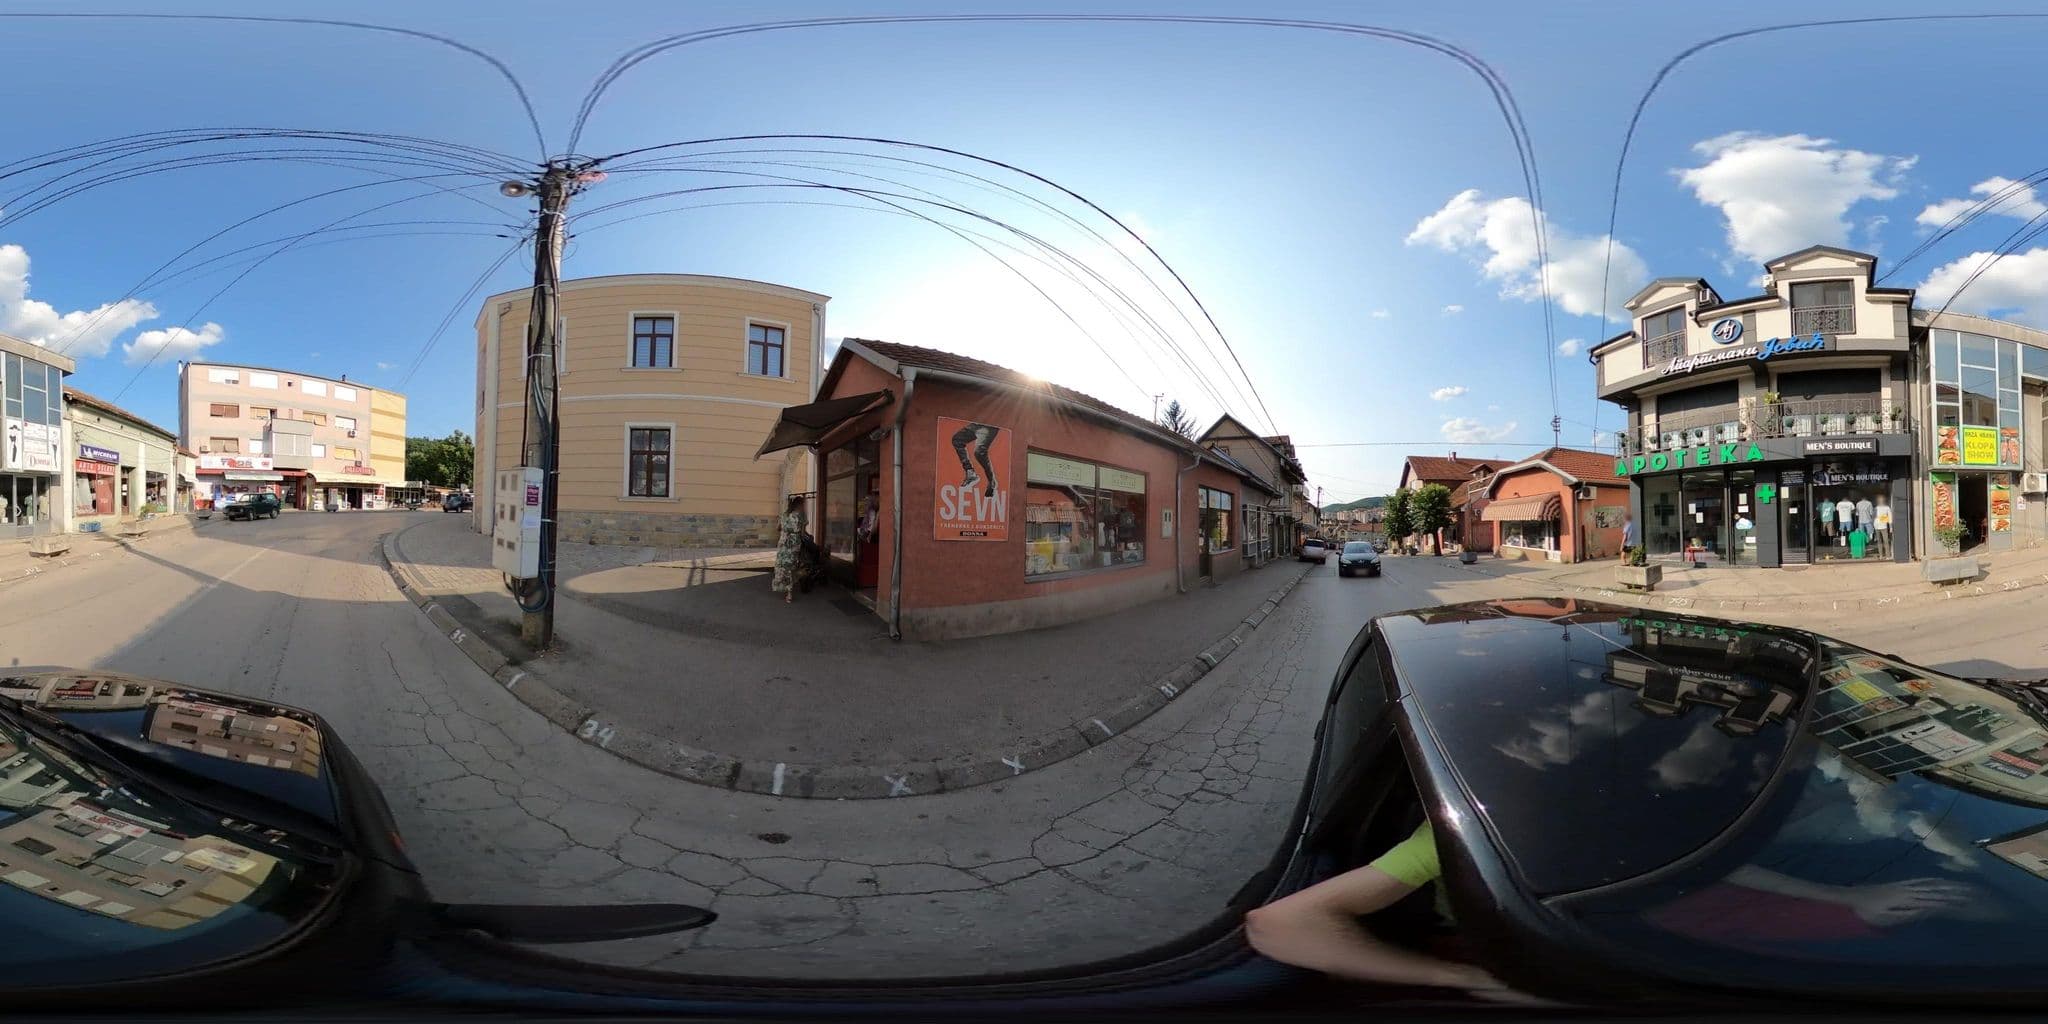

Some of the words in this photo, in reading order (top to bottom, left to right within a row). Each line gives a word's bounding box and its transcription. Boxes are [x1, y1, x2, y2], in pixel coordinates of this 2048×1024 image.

[1757, 331, 1825, 360] Јовић
[1806, 442, 1833, 451] MEN'S
[1834, 441, 1873, 450] BOUTIQUE
[1966, 441, 1995, 450] KLOPA
[1615, 443, 1765, 476] APOTEKA
[1967, 451, 1994, 459] SHOW
[1831, 473, 1855, 482] MEN'S
[1855, 473, 1889, 481] BOUTIQUE
[940, 484, 1007, 523] SEVN
[449, 628, 466, 644] 35
[581, 718, 615, 748] 34
